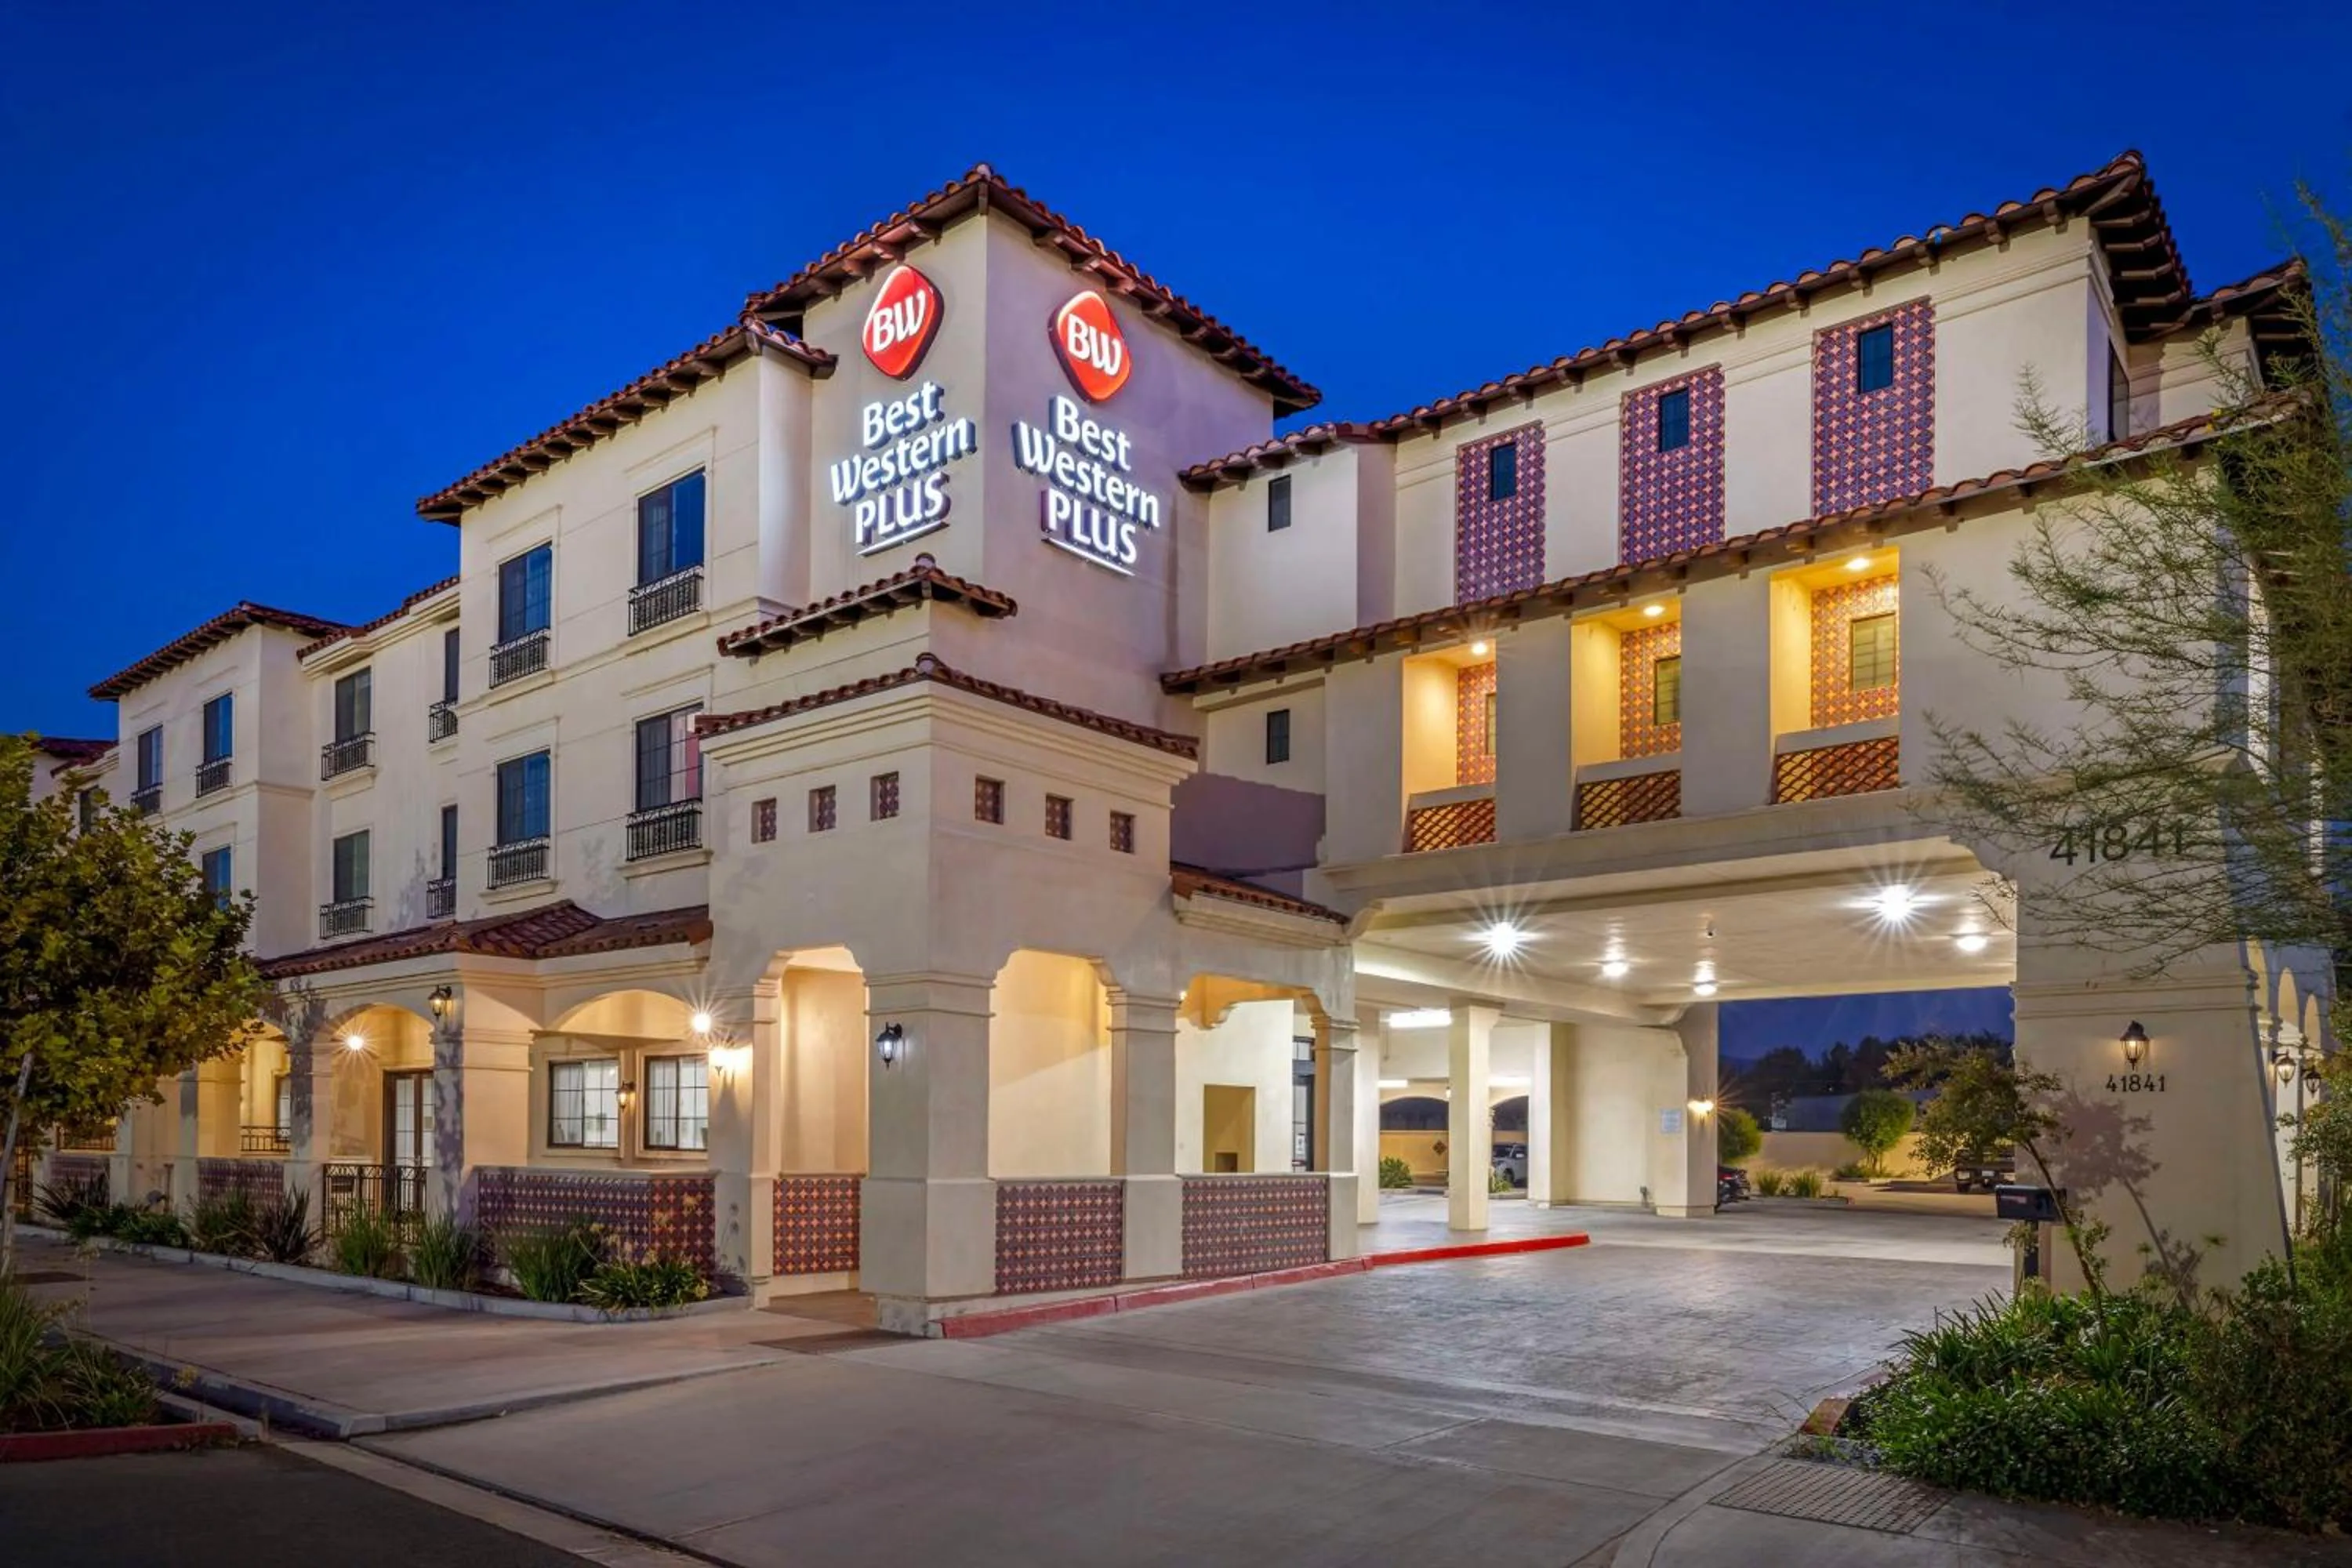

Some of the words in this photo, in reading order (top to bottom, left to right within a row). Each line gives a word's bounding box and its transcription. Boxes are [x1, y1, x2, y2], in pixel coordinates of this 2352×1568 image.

[872, 289, 926, 353] BW
[1066, 314, 1123, 376] BW
[863, 381, 940, 448] Best
[1054, 395, 1131, 470] Best
[830, 417, 971, 504] Western
[1017, 422, 1160, 528] Western
[855, 472, 947, 544] PLUS
[1047, 487, 1138, 564] PLUS
[2049, 819, 2184, 866] 41841
[2106, 1073, 2165, 1092] 41841
